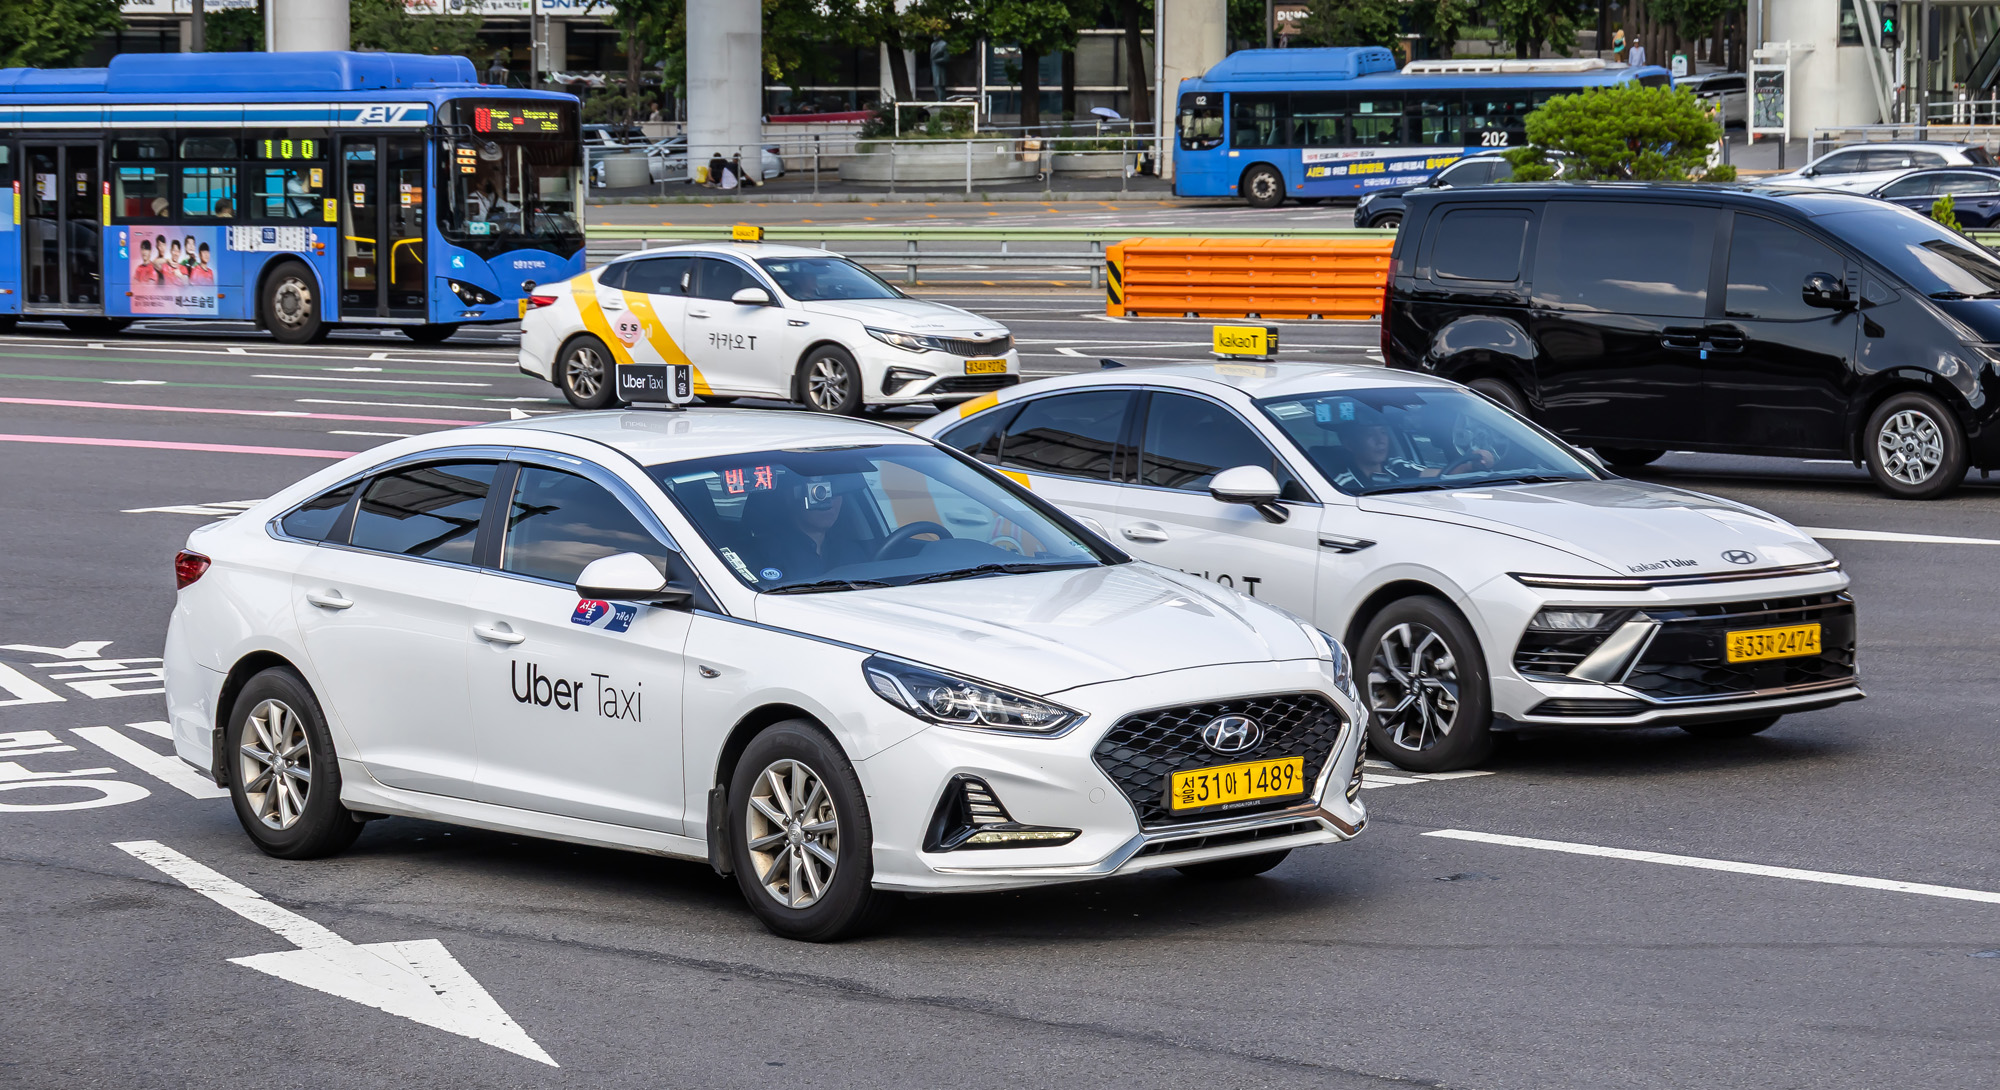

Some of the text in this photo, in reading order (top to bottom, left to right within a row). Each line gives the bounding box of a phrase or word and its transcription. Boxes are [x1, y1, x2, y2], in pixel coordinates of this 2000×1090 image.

[366, 106, 402, 123] EV
[1481, 131, 1508, 146] 202
[264, 139, 313, 159] 100
[708, 332, 757, 351] 카카오 T
[622, 373, 664, 390] Uber Taxi
[677, 368, 687, 395] 서울
[1669, 558, 1699, 568] blue
[580, 600, 597, 619] 서울
[615, 611, 634, 628] 개인
[1777, 629, 1815, 654] 2474
[511, 659, 642, 723] Uber Taxi
[1243, 763, 1295, 794] 1489
